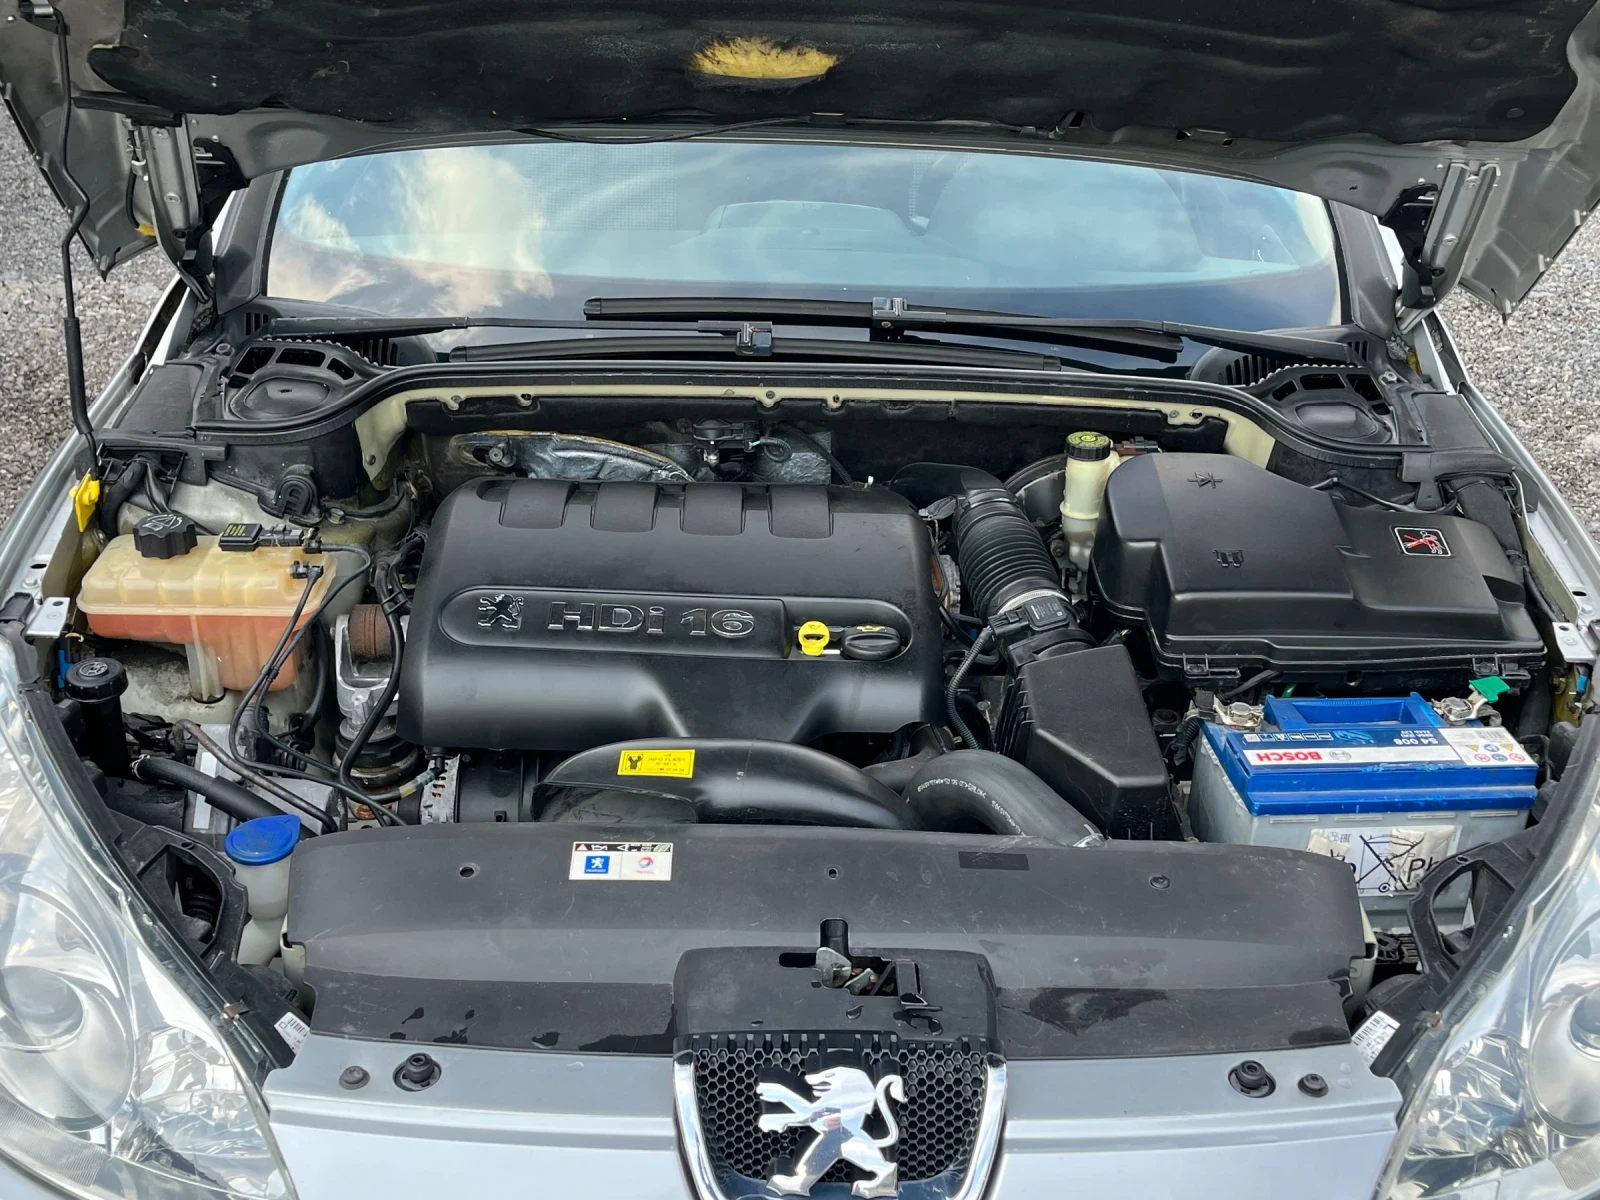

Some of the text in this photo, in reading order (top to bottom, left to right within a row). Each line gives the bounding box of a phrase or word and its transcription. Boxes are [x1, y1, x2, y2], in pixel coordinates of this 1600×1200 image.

[547, 601, 755, 639] HDi 16
[1392, 737, 1439, 745] S4 008
[1256, 751, 1322, 762] BOSCH
